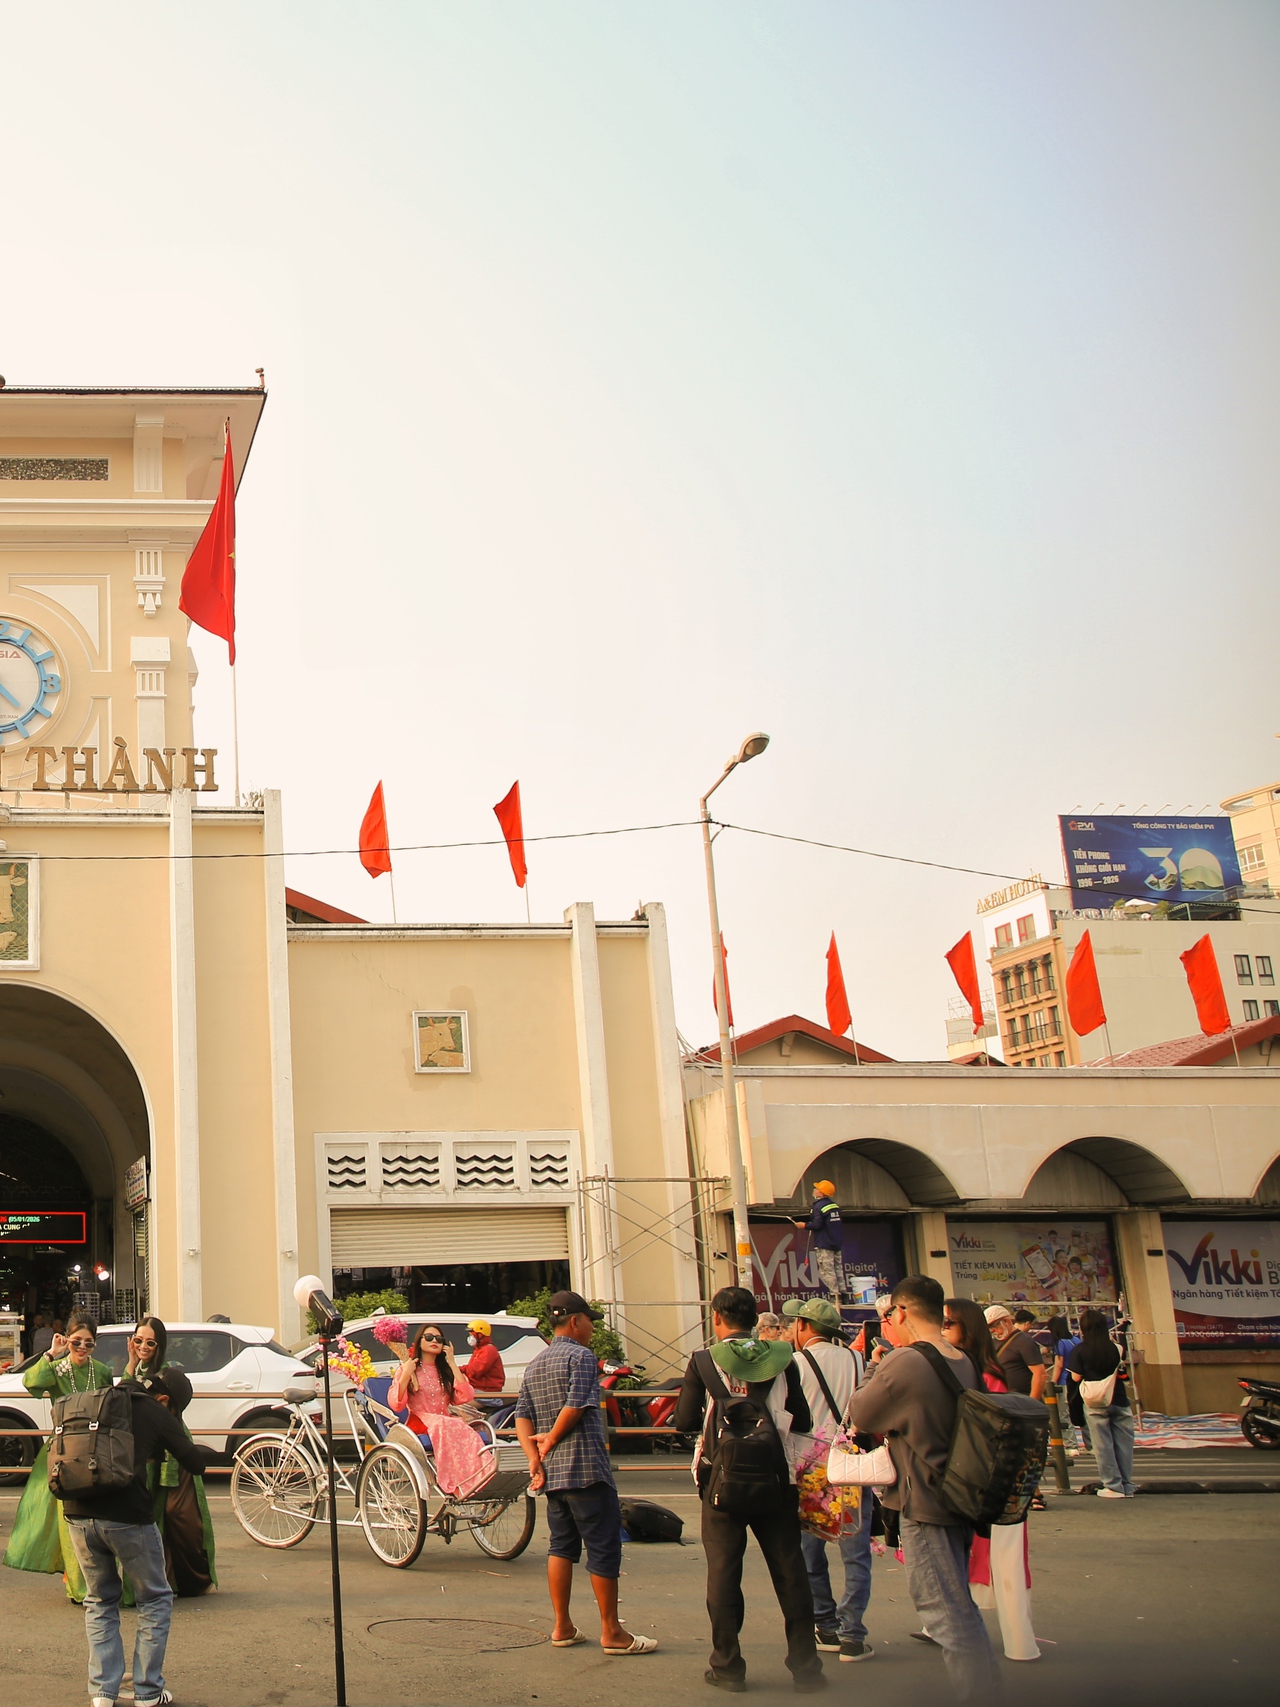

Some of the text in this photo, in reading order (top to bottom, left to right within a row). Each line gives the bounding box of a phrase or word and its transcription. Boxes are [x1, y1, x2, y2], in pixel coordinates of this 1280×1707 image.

[42, 673, 62, 694] 3
[24, 735, 219, 792] THÀNH
[1076, 821, 1094, 829] PVI
[1132, 822, 1150, 830] TỔNG
[1150, 822, 1167, 830] CÔNG
[1176, 822, 1189, 830] BẢO
[1072, 848, 1110, 860] TIÊN PHONG
[1075, 862, 1126, 875] KHÔNG GIỚI HẠN
[1137, 847, 1225, 891] 30
[1077, 878, 1093, 888] 1996
[1103, 874, 1120, 885] 2026
[976, 872, 1045, 915] A&EM HOTEL
[951, 1232, 982, 1248] Vikki
[1167, 1231, 1263, 1285] Vikki
[954, 1259, 973, 1269] TIẾT
[974, 1260, 995, 1271] KIỆM
[955, 1271, 978, 1280] Trúng
[1173, 1289, 1198, 1300] Ngân
[1199, 1289, 1224, 1300] hàng
[1224, 1287, 1244, 1298] Tiết
[1246, 1288, 1269, 1300] kiệm
